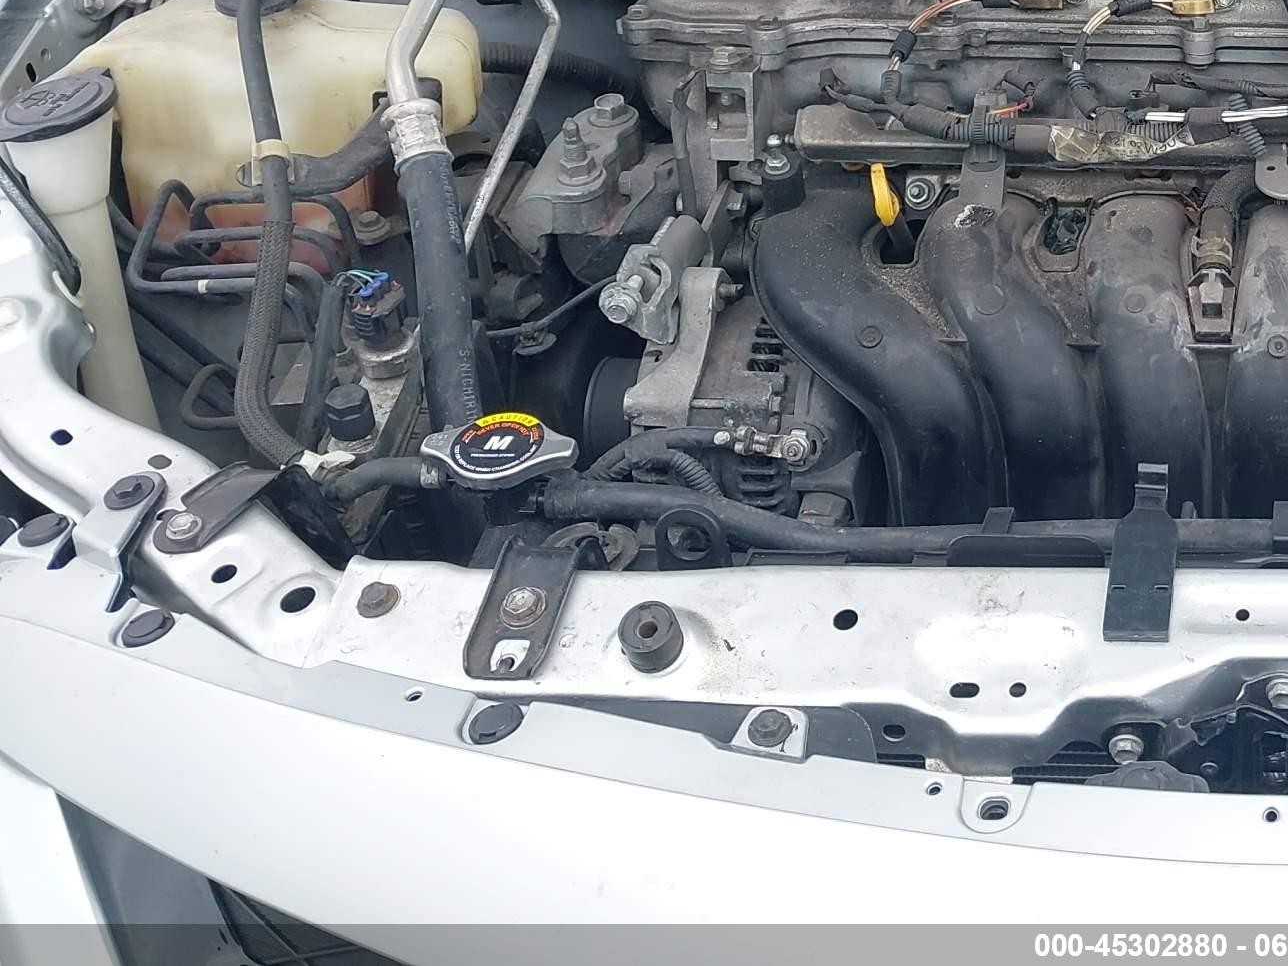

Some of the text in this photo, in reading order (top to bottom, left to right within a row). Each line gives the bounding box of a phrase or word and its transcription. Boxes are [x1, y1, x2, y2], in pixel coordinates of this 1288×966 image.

[491, 414, 534, 424] CAUTION
[476, 422, 501, 436] NEVER
[484, 436, 513, 449] M
